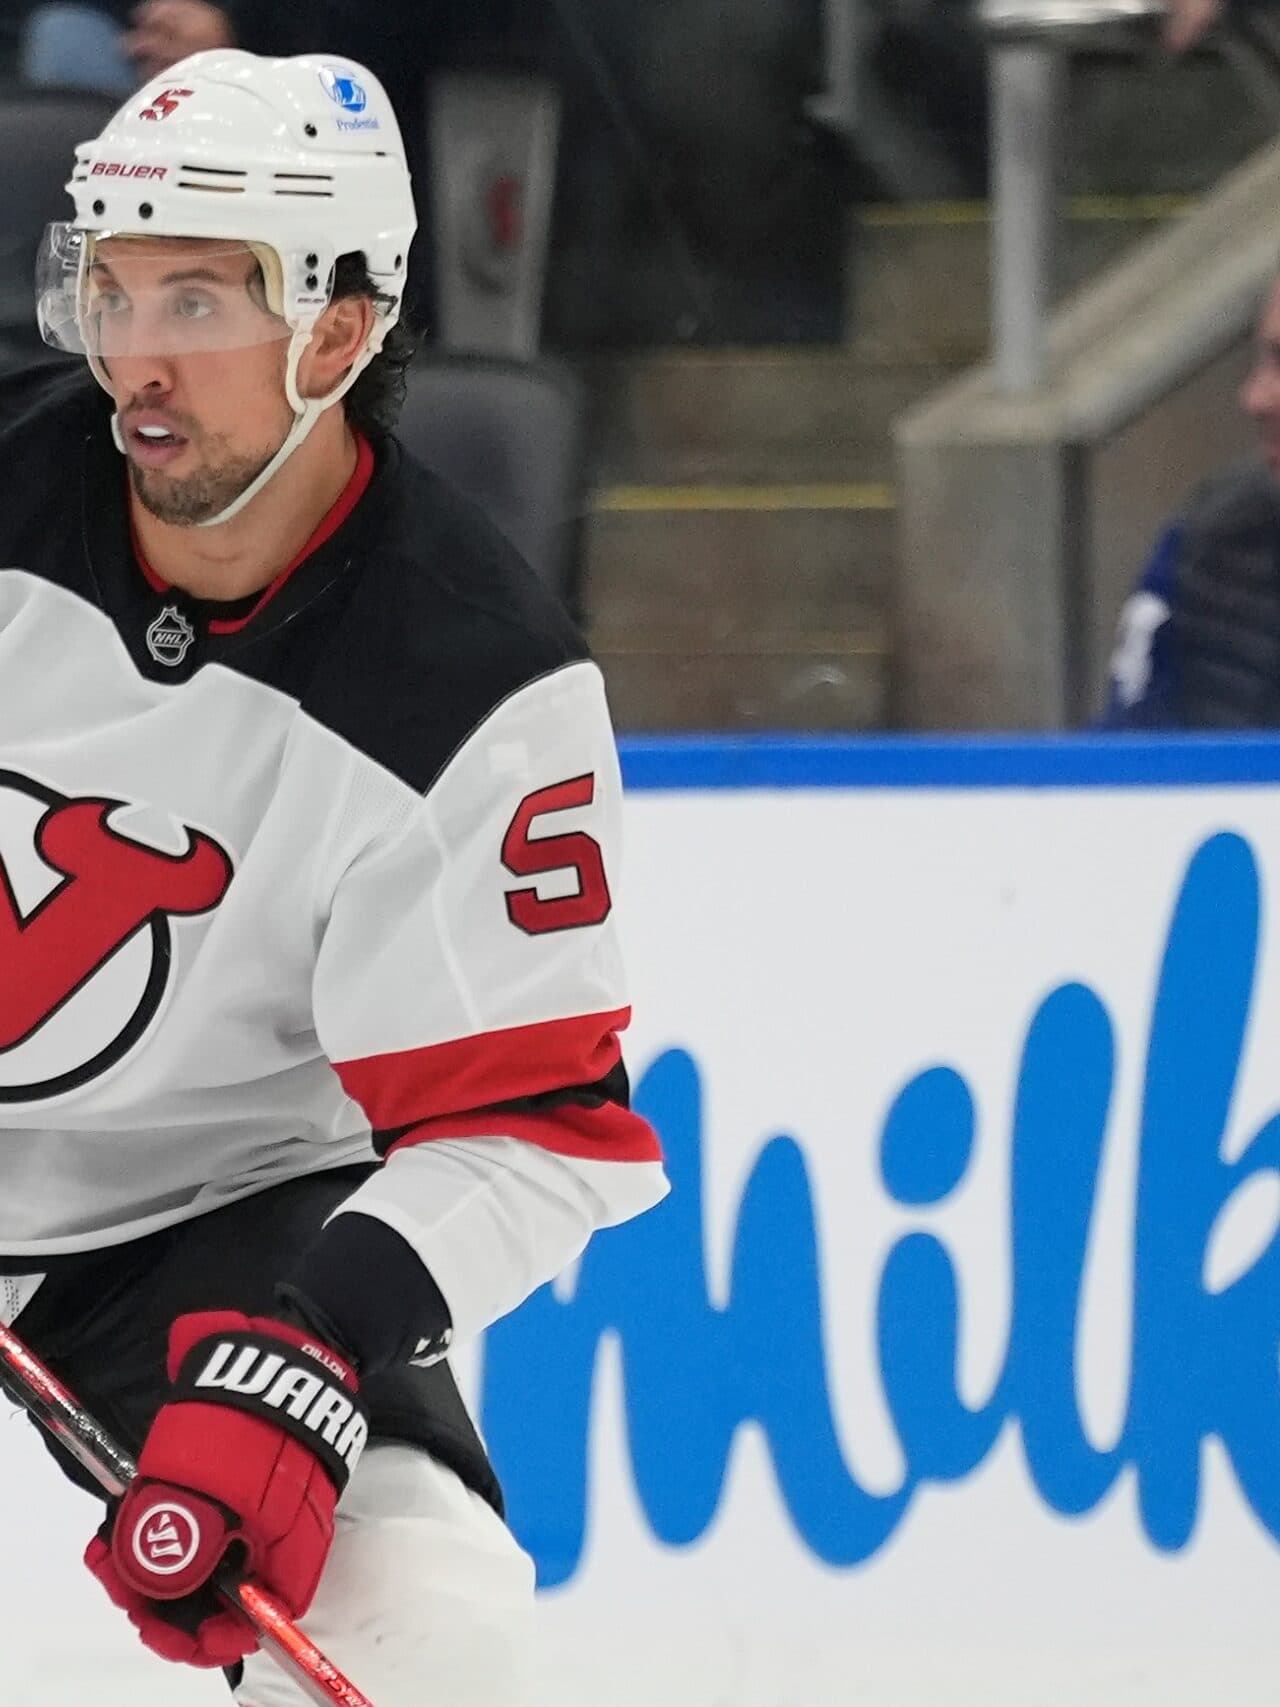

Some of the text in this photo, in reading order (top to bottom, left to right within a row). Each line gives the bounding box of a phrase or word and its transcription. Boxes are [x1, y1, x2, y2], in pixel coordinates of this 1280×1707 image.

[138, 87, 196, 121] 5
[335, 117, 380, 132] Prudential
[91, 161, 168, 181] BAUER
[153, 631, 182, 646] NHL
[500, 770, 613, 937] 5
[300, 1343, 348, 1381] DILLON
